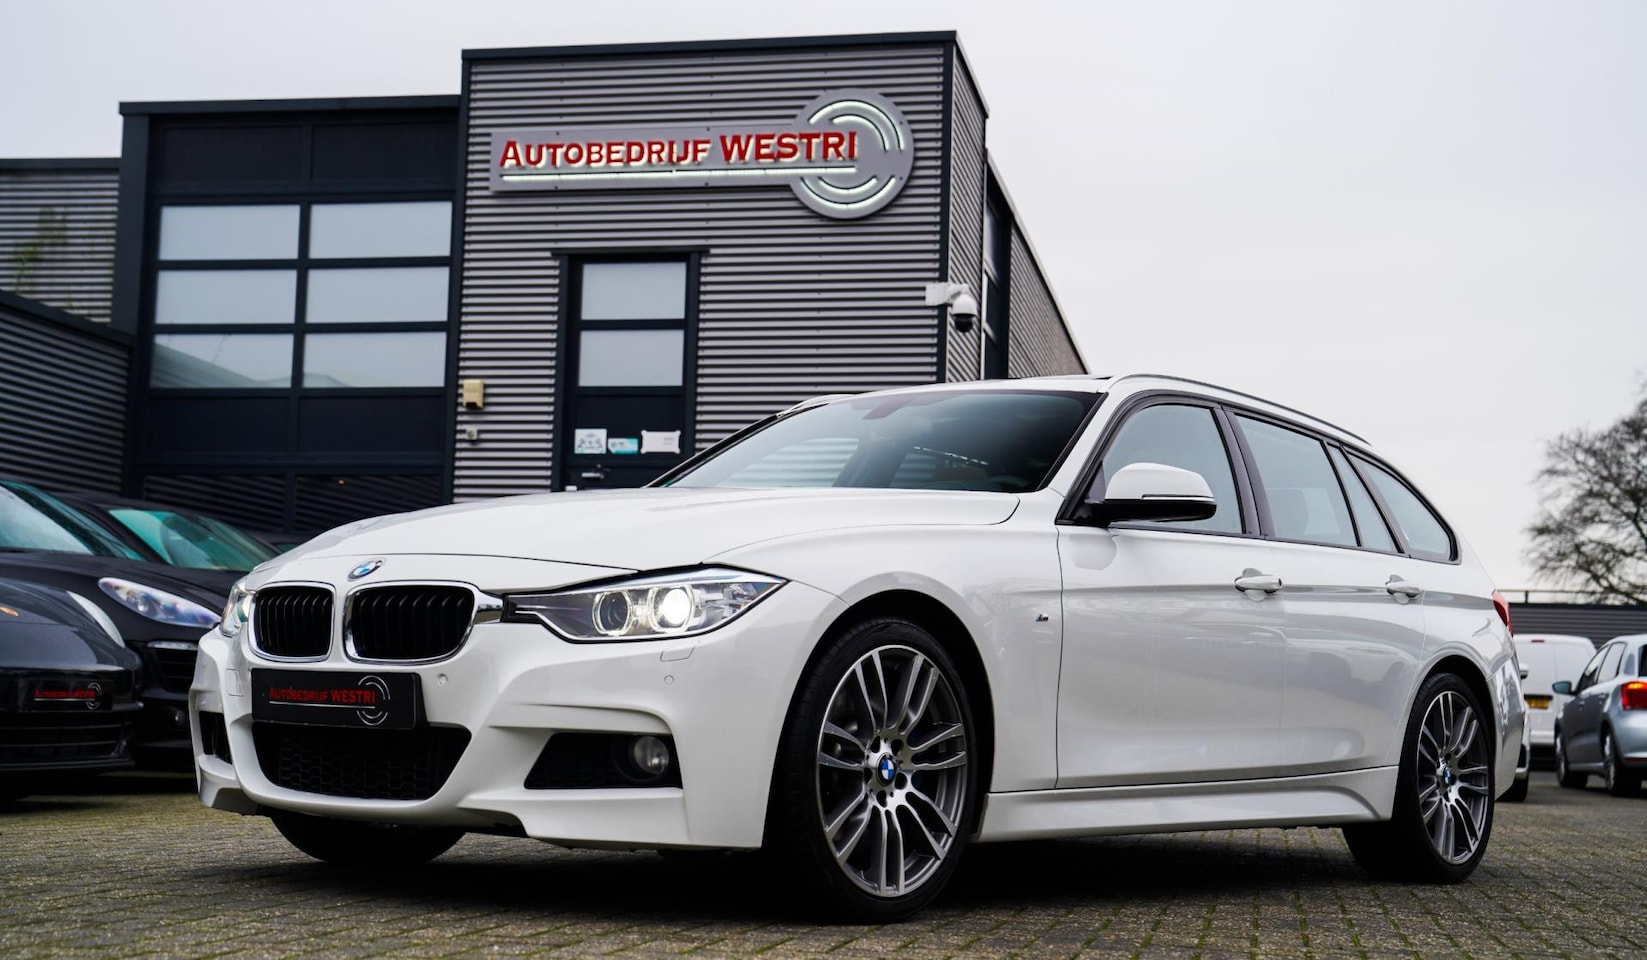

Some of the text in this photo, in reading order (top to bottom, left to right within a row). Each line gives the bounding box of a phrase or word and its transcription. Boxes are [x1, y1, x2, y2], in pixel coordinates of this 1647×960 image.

[500, 131, 857, 167] AUTOBEDRIJF WESTRI
[330, 689, 376, 704] WESTRI
